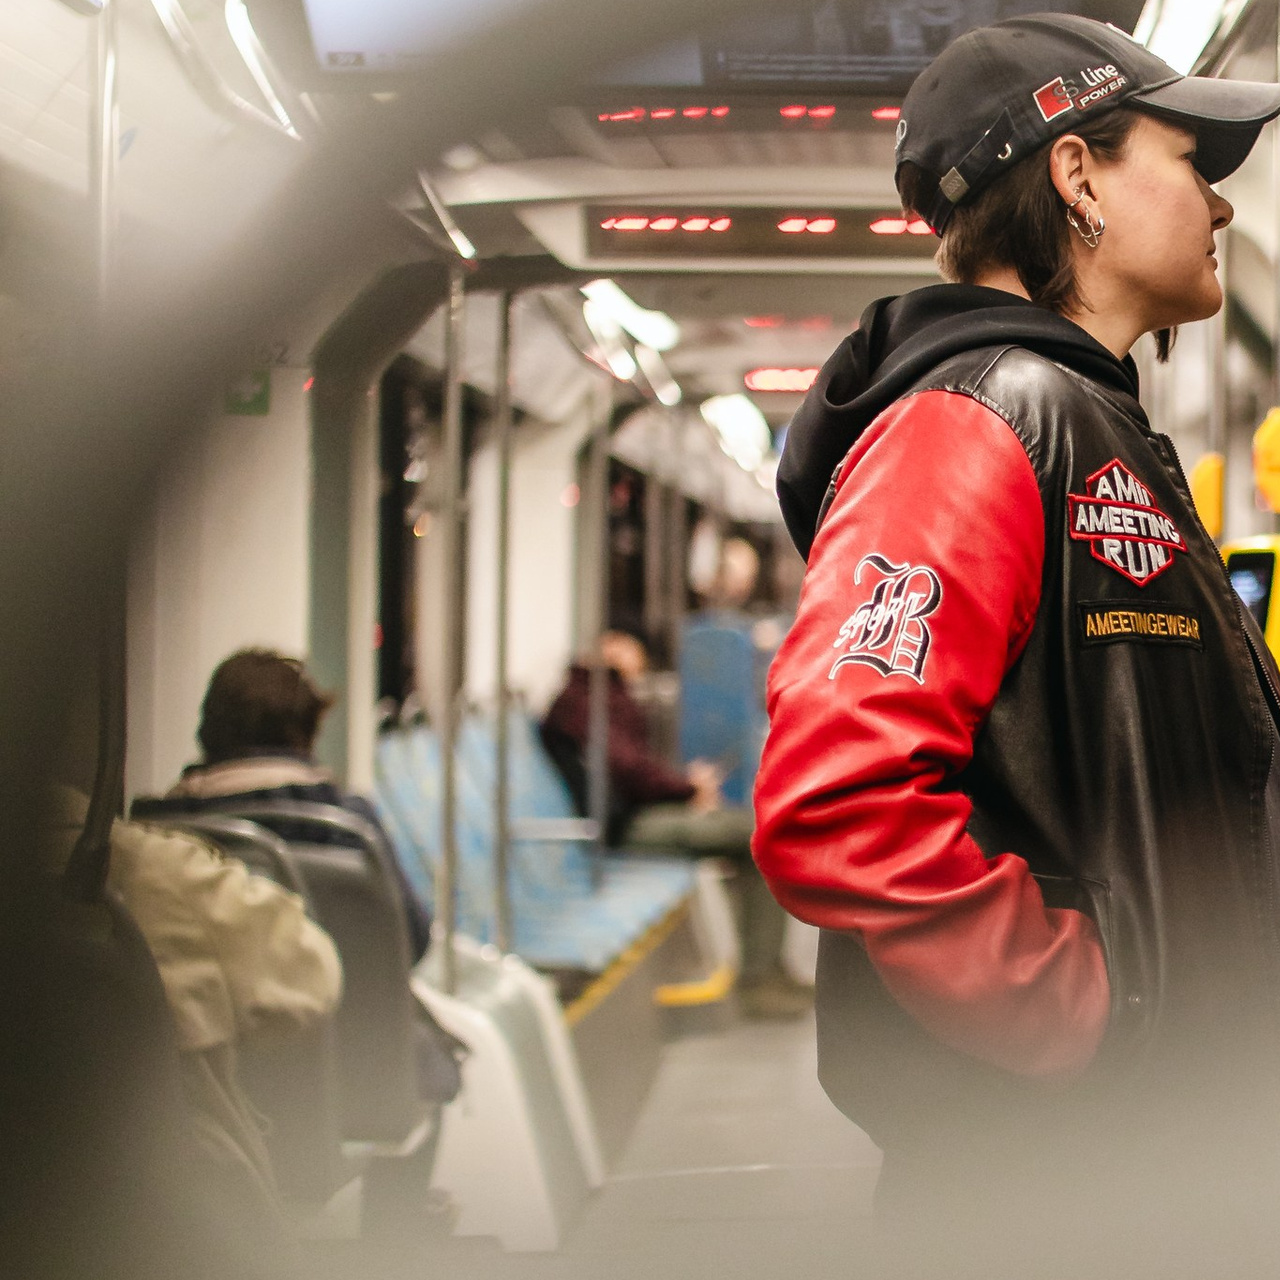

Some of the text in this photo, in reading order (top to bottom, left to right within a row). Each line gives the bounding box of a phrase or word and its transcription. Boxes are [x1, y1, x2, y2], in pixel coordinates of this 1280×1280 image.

[1080, 64, 1119, 87] Line
[1079, 76, 1127, 107] POWER
[1075, 504, 1180, 544] AMEETING
[1103, 538, 1167, 578] RUN
[1086, 611, 1200, 640] AMEETINGEWEAR
